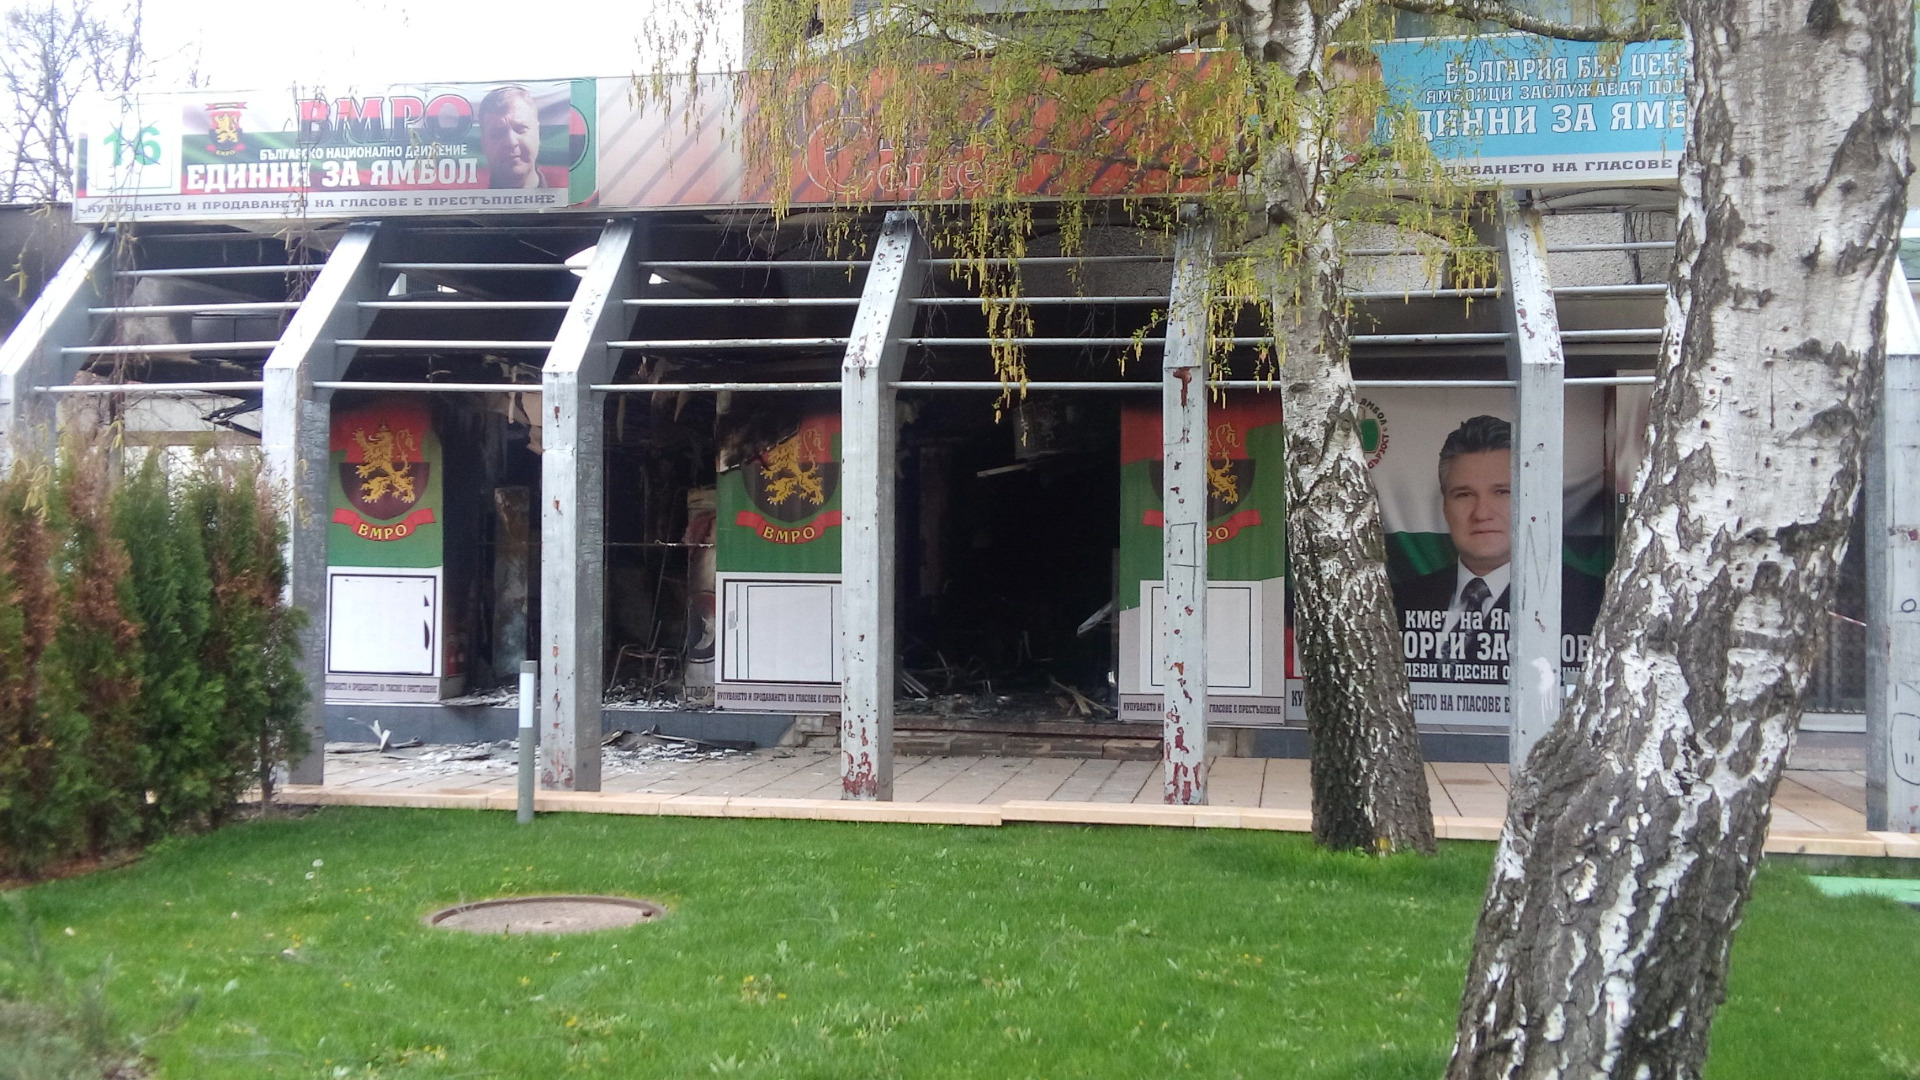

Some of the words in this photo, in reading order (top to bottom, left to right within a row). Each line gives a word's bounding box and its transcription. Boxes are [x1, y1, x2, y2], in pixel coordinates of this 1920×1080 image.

[1446, 57, 1568, 84] БЪЛГАРИЯ
[296, 94, 473, 144] ВМРО
[1388, 105, 1537, 142] ДИННИ
[1551, 103, 1597, 133] ЗА
[1610, 100, 1685, 131] ЯМБ
[104, 127, 162, 167] 16
[326, 146, 402, 159] НАЦИОНАЛНО
[187, 162, 311, 192] ЕДИННИ
[322, 160, 360, 187] ЗА
[370, 158, 478, 185] ЯМБОЛ
[1552, 162, 1578, 173] НА
[1584, 159, 1673, 172] ГЛАСОВЕ
[187, 202, 196, 210] И
[315, 199, 334, 207] НА
[341, 198, 407, 208] ГЛАСОВЕ
[414, 198, 422, 206] Е
[429, 194, 555, 206] ПРЕСТЪПЛЕНИЕ
[358, 523, 407, 540] ВМРО
[763, 525, 815, 543] ВМРО
[1405, 610, 1450, 629] кмет
[1460, 611, 1483, 630] на
[1399, 630, 1466, 659] ОРГИ
[1405, 663, 1437, 678] ЛЕВИ
[1442, 664, 1451, 678] И
[1455, 664, 1498, 680] ДЕСНИ
[1441, 695, 1453, 711] НА
[1457, 695, 1501, 712] ГЛАСОВЕ
